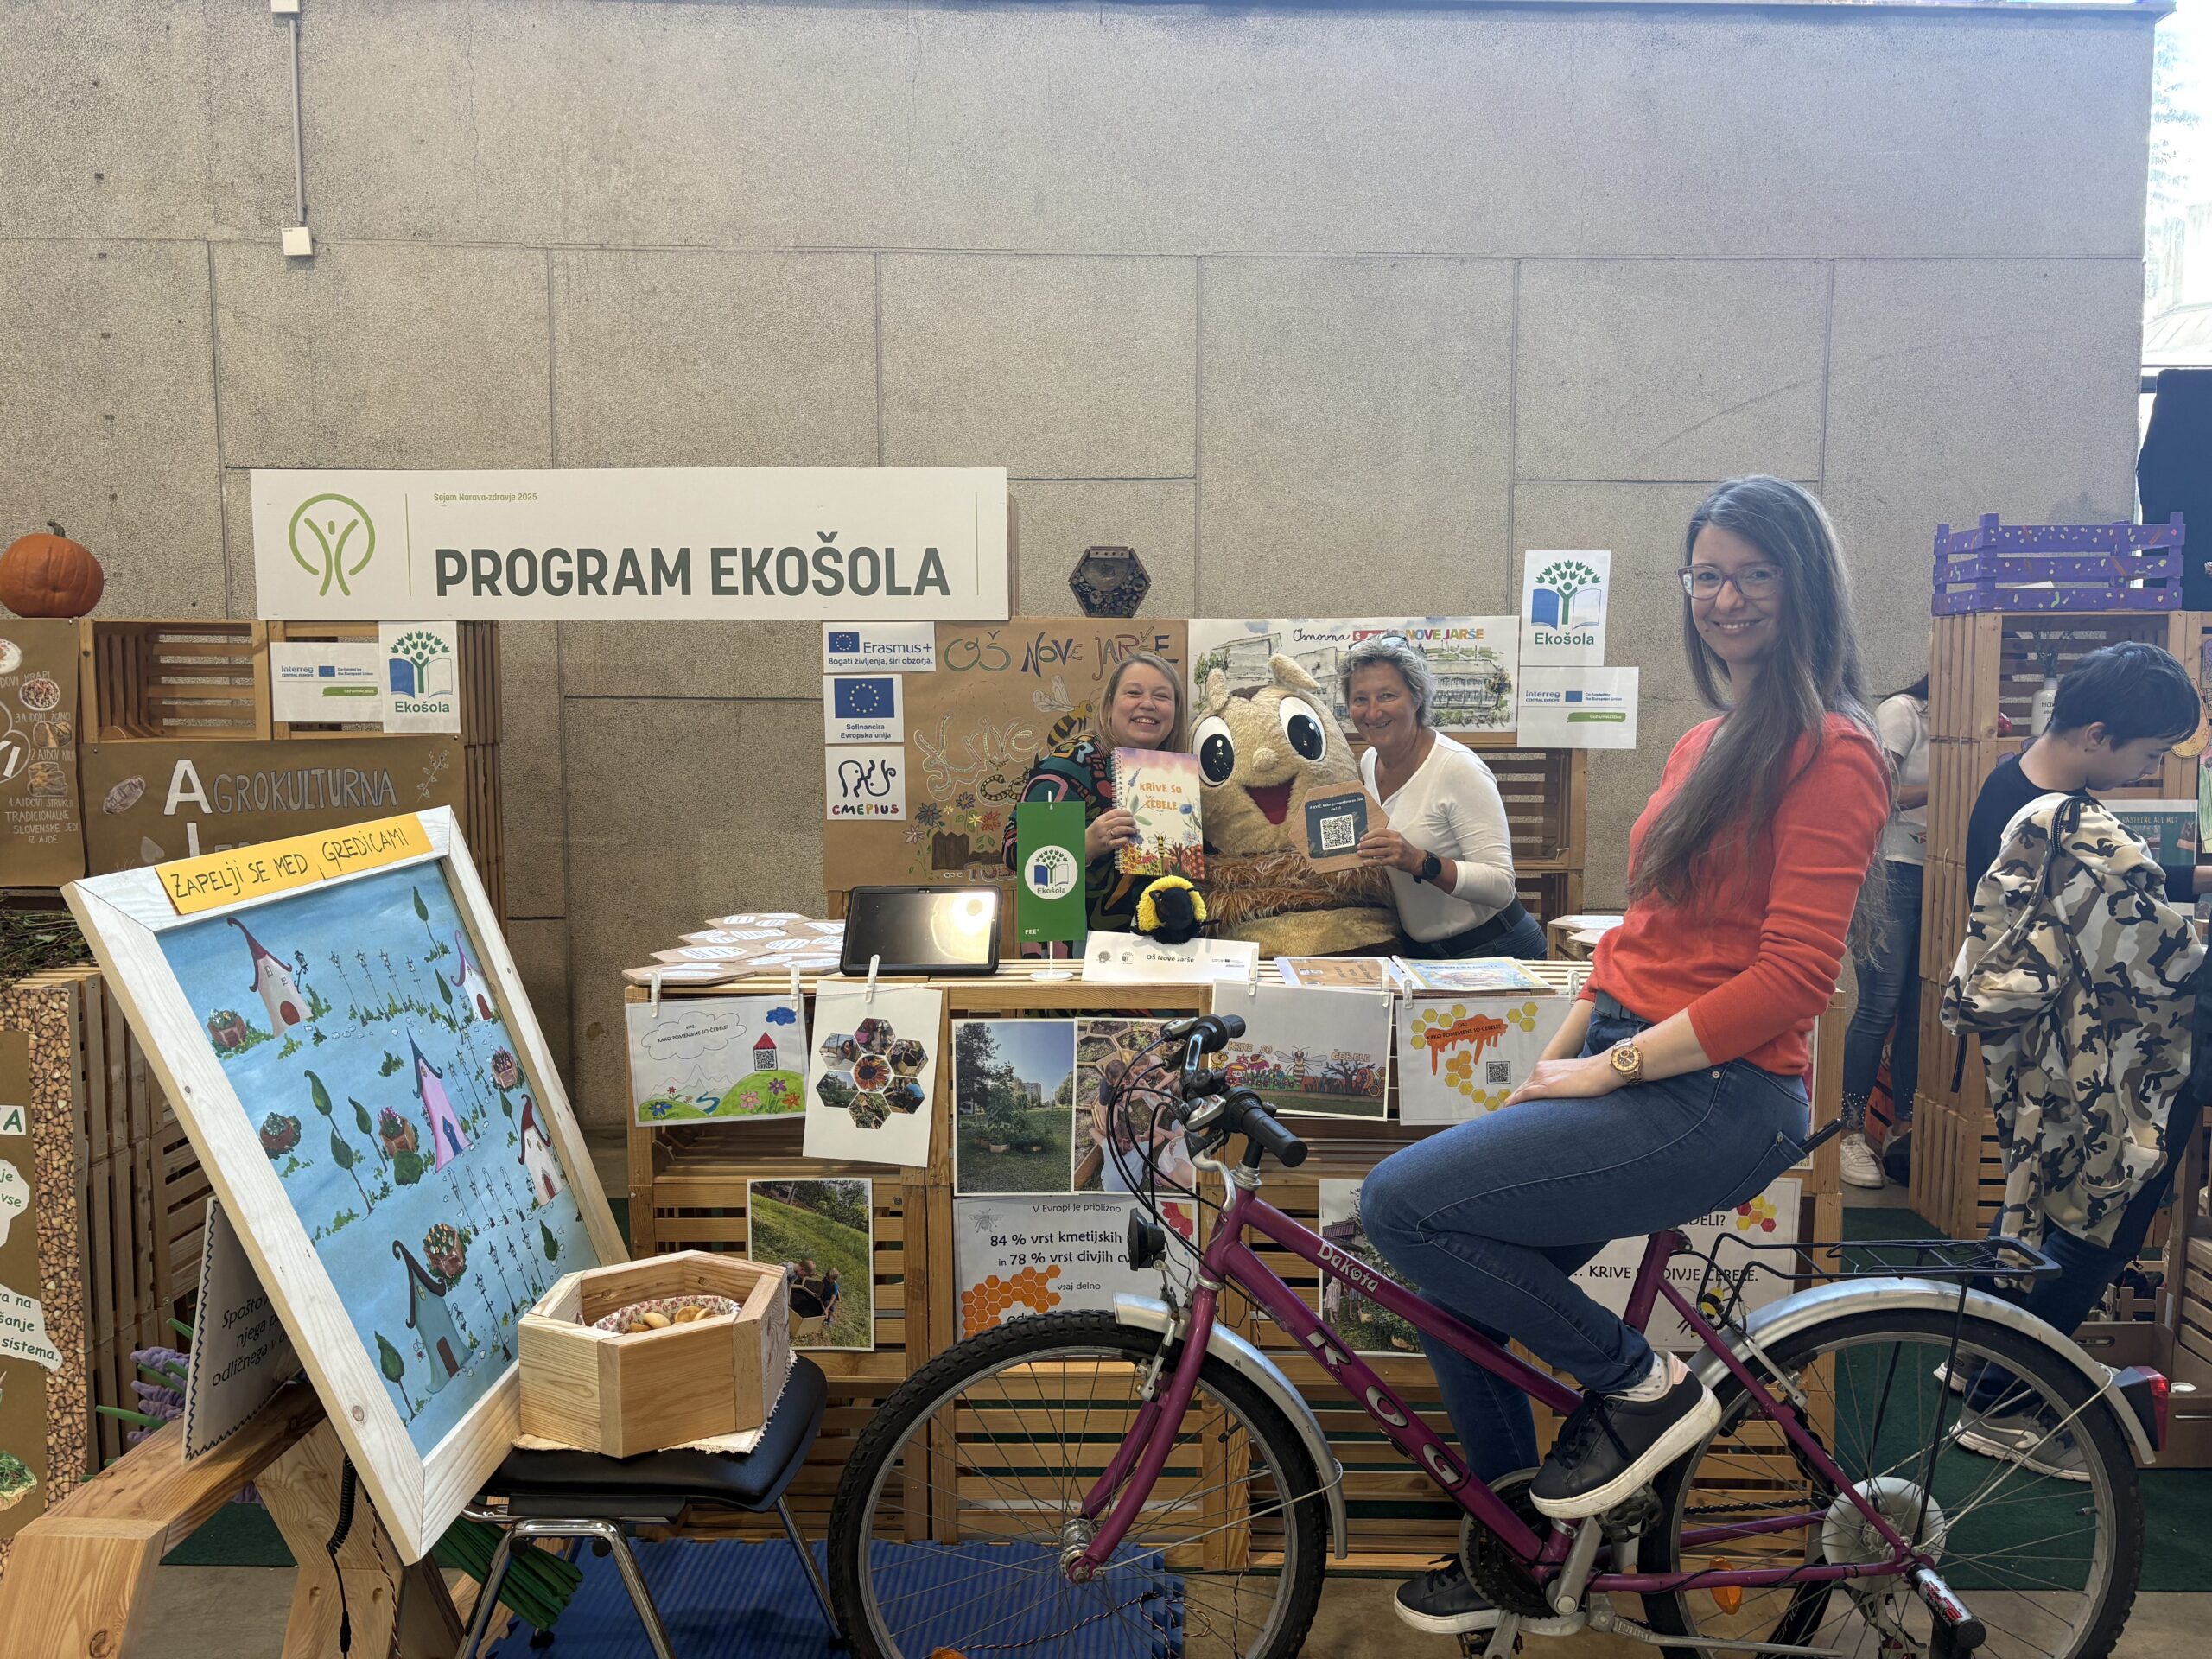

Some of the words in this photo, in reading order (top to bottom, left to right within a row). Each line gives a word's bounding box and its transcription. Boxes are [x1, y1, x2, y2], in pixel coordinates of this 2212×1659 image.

[434, 493, 456, 502] Sejem
[459, 493, 516, 502] Narava-zdravje
[518, 493, 537, 501] 2025
[435, 548, 691, 596] PROGRAM
[710, 531, 950, 596] EKOŠOLA
[1293, 628, 1351, 642] Osnovna
[1406, 628, 1440, 640] NOVE
[1442, 628, 1484, 640] JARŠE
[1535, 632, 1594, 645] Ekošola
[863, 642, 932, 653] Erasmus+
[944, 630, 1011, 672] OŠ
[829, 657, 853, 666] Bogati
[855, 657, 887, 665] življenja,
[889, 656, 900, 664] širi
[902, 657, 933, 665] obzorja.
[0, 675, 18, 688] DOVI
[395, 701, 449, 713] Ekošola
[164, 760, 397, 815] AGROKULTURNA
[1145, 794, 1178, 810] ČEBELE
[4, 810, 69, 821] TRADICIONALNE
[832, 804, 899, 816] CMEPIUS
[14, 823, 60, 835] SLOVENSKE
[65, 822, 78, 832] JEDI
[29, 835, 35, 843] IZ
[39, 834, 58, 843] AJDE
[249, 861, 270, 884] SE
[275, 853, 308, 877] MED
[322, 823, 409, 871] GREDICAMI
[672, 1031, 701, 1039] POMEMBNE
[1443, 1029, 1472, 1038] POMEMBNE
[1228, 1041, 1253, 1052] KRIVE
[1261, 1045, 1272, 1054] SO
[1332, 1048, 1370, 1062] ČEBELE
[1, 1193, 22, 1207] vse
[1043, 1204, 1071, 1214] Evropi
[1073, 1203, 1081, 1214] je
[1084, 1202, 1122, 1214] približno
[1688, 1214, 1726, 1226] ELI?
[990, 1236, 1007, 1247] 84
[1012, 1235, 1027, 1245] %
[1031, 1234, 1054, 1243] vrst
[1058, 1230, 1122, 1244] kmetijskih
[998, 1257, 1007, 1266] in
[1010, 1254, 1027, 1266] 78
[1031, 1253, 1046, 1264] %
[1050, 1251, 1073, 1262] vrst
[1077, 1249, 1113, 1264] divjih
[1317, 1241, 1379, 1294] Dakota
[1590, 1265, 1631, 1279] KRIVE
[1057, 1282, 1073, 1292] vsaj
[1076, 1281, 1101, 1291] delno
[16, 1296, 32, 1309] na
[222, 1295, 270, 1329] Spoštov
[236, 1319, 266, 1348] njega
[1, 1337, 59, 1362] sistema.
[212, 1343, 268, 1387] odličnega
